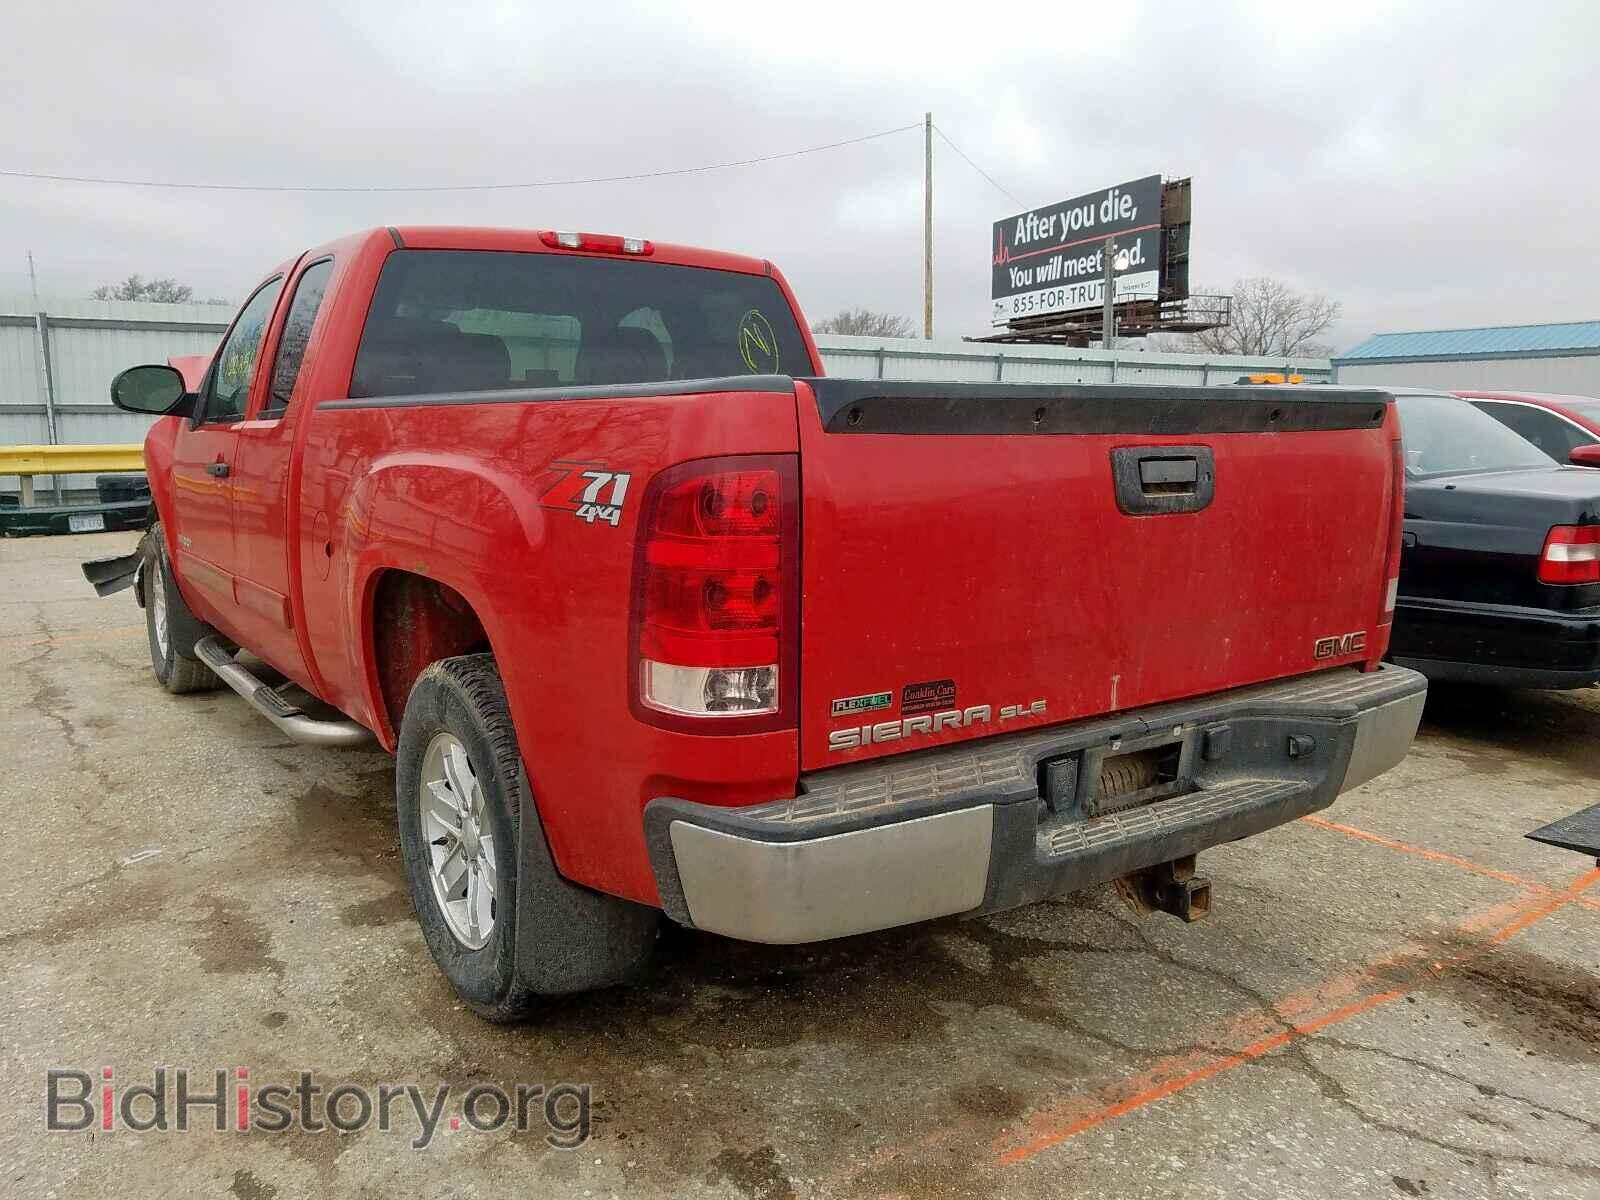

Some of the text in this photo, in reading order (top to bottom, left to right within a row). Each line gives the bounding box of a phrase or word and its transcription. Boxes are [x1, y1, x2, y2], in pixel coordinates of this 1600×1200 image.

[1014, 189, 1138, 246] After you die,
[1009, 266, 1033, 289] You
[1036, 255, 1063, 281] will
[1064, 250, 1102, 278] meet
[1315, 630, 1367, 661] GMC
[828, 700, 1047, 752] SIERRA SLE
